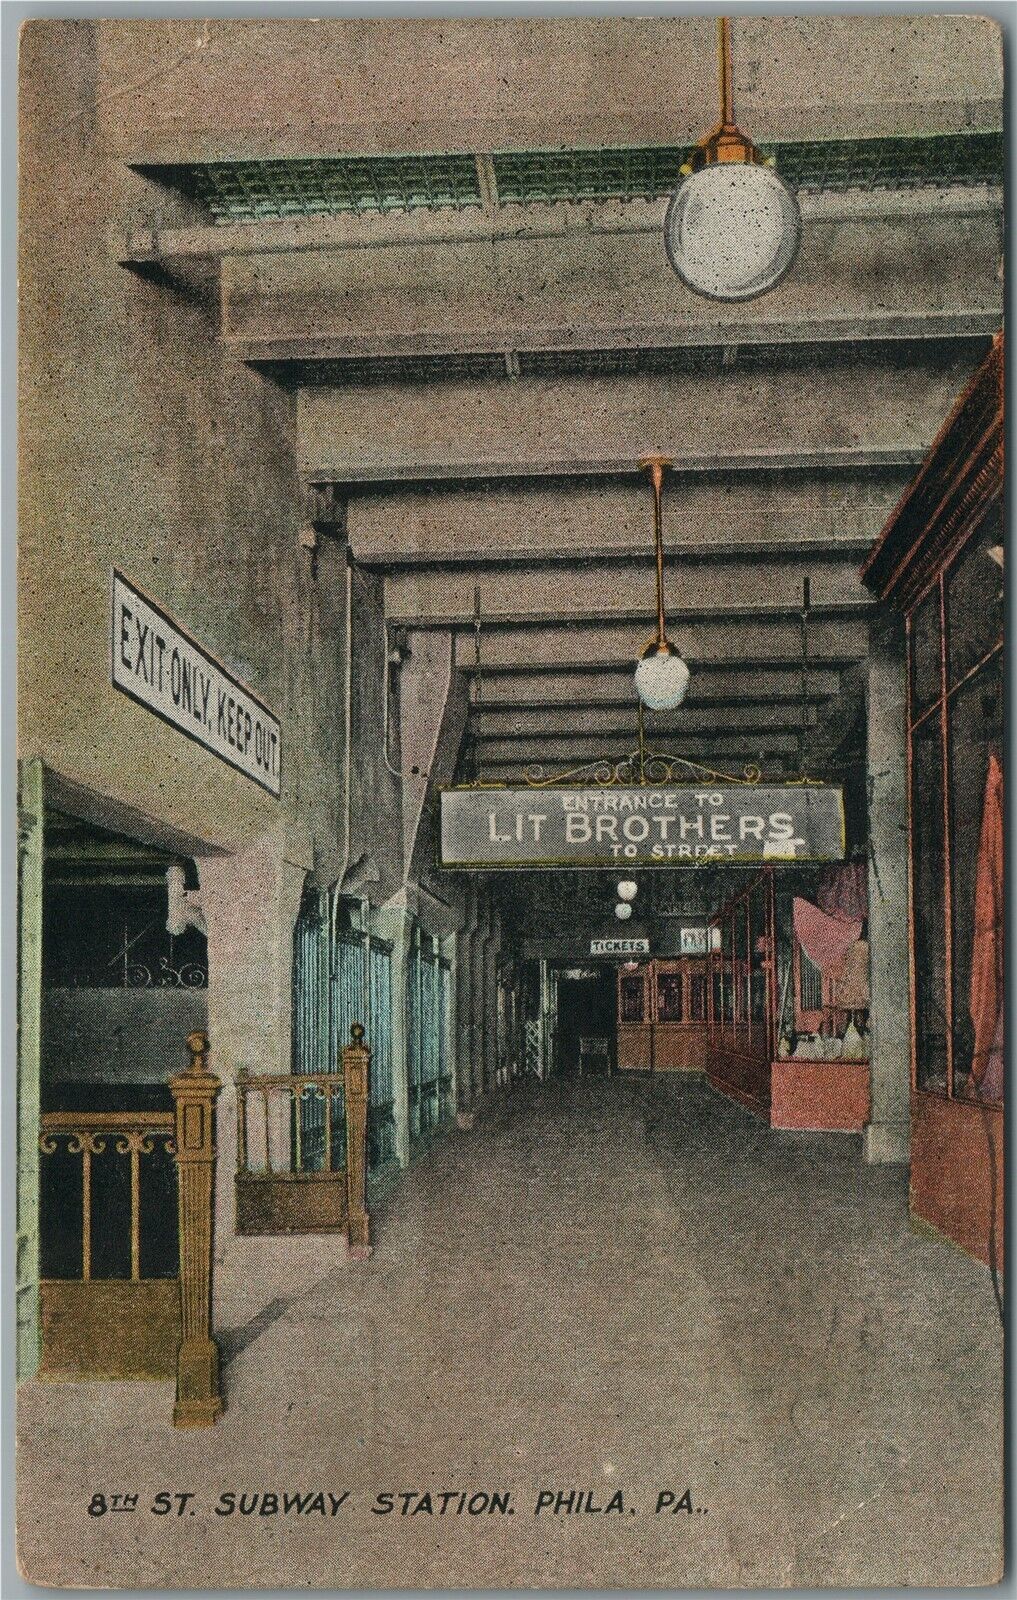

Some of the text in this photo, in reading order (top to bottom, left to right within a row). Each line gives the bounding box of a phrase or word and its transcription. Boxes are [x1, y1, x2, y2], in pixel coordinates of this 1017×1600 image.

[121, 604, 166, 692] EXIT
[218, 688, 251, 755] KEEP
[255, 720, 277, 776] OUT
[563, 792, 723, 811] ENTRANCE TO
[488, 812, 796, 844] LIT BROTHERS
[610, 844, 638, 858] TO
[592, 941, 646, 952] TICKETS
